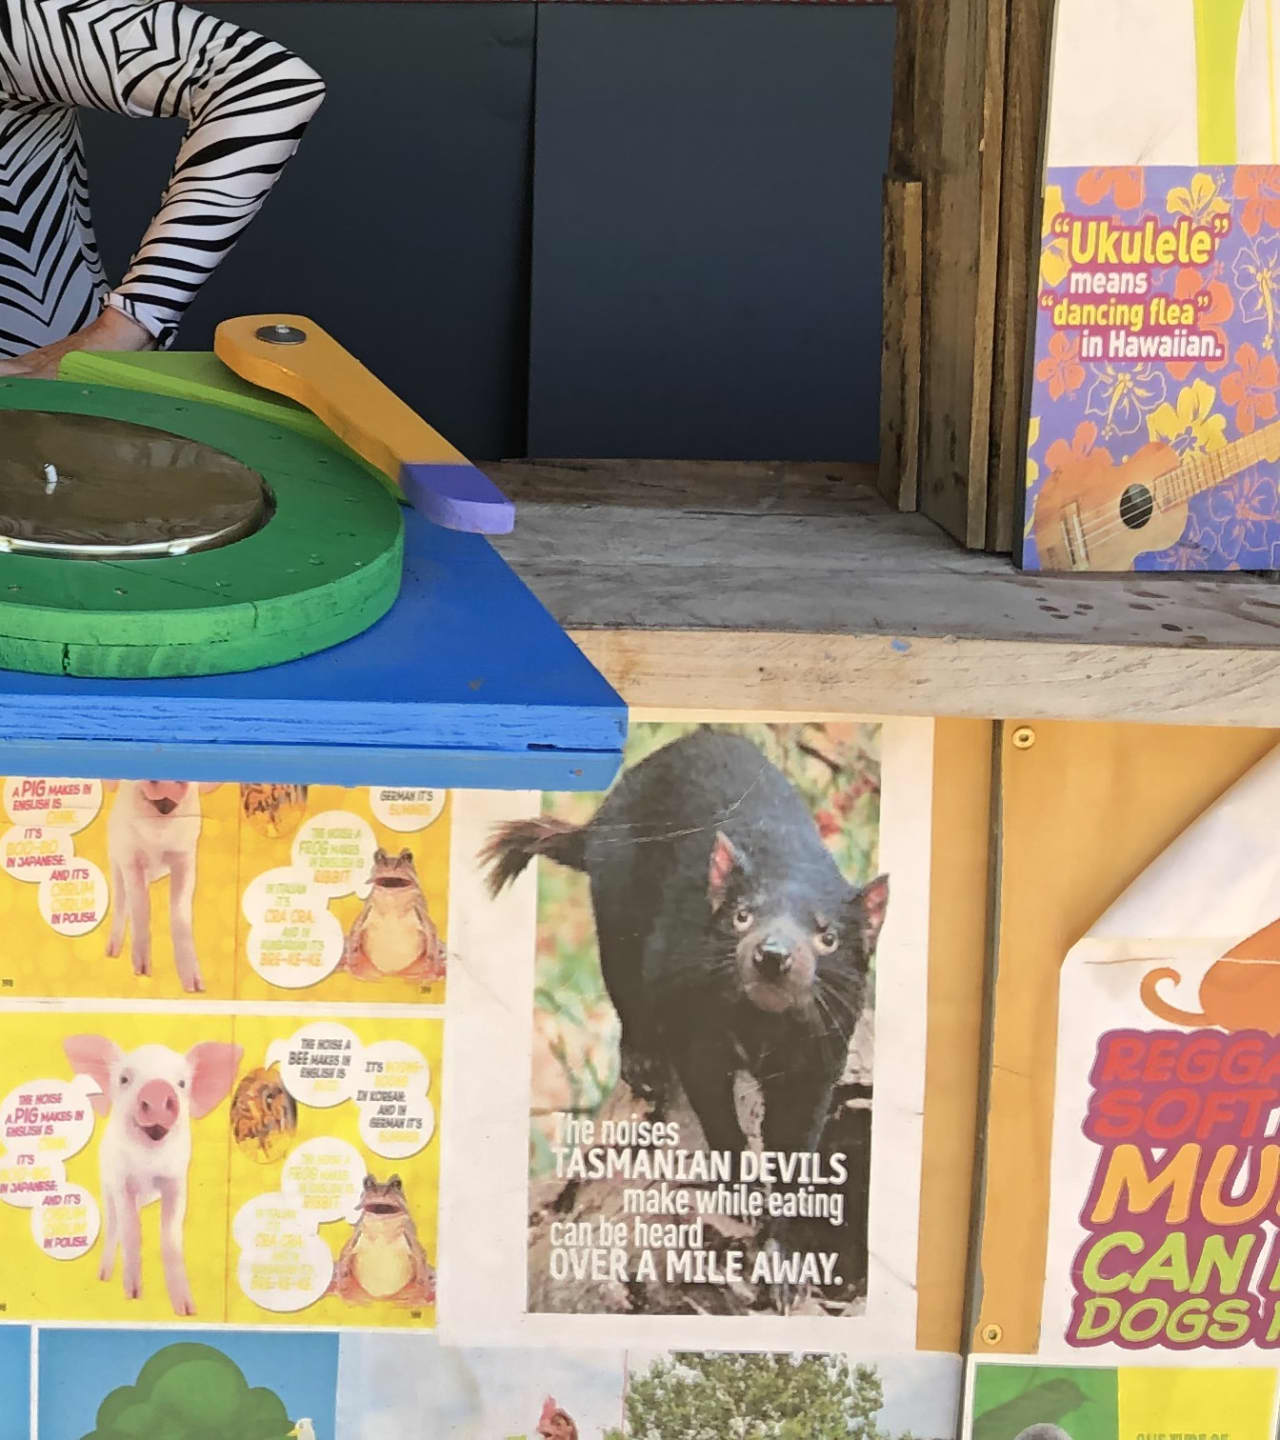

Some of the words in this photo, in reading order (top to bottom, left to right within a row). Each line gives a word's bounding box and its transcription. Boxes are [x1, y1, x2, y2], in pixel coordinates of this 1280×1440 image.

[1054, 217, 1230, 265] “Ukulele”
[1069, 270, 1149, 294] means
[1041, 295, 1144, 332] “dancing
[1149, 295, 1209, 327] flea”
[1081, 329, 1103, 358] in
[1109, 329, 1222, 358] Hawaiian.
[21, 779, 46, 798] PIG
[47, 784, 81, 796] MAKES
[82, 784, 93, 795] IN
[52, 798, 62, 809] IS
[24, 828, 42, 839] IT'S
[49, 869, 70, 881] AND
[71, 868, 90, 880] IT'S
[288, 1051, 309, 1066] BEE
[14, 1107, 39, 1124] PIG
[40, 1111, 73, 1123] MAKES
[74, 1110, 85, 1121] IN
[1093, 1088, 1280, 1139] SOFT
[552, 1112, 594, 1145] The
[601, 1113, 680, 1147] noises
[17, 1154, 35, 1165] IT'S
[550, 1148, 731, 1182] TASMANIAN
[740, 1150, 848, 1185] DEVILS
[42, 1195, 62, 1206] AND
[63, 1194, 81, 1205] IT'S
[623, 1182, 690, 1215] make
[696, 1183, 764, 1217] while
[768, 1185, 844, 1226] eating
[550, 1220, 594, 1247] can
[599, 1215, 628, 1247] be
[634, 1216, 704, 1249] heard
[550, 1248, 630, 1283] OVER
[636, 1249, 658, 1283] A
[666, 1250, 744, 1285] MILE
[751, 1252, 844, 1286] AWAY.
[1082, 1231, 1256, 1295] CAN
[1076, 1297, 1251, 1343] DOGS
